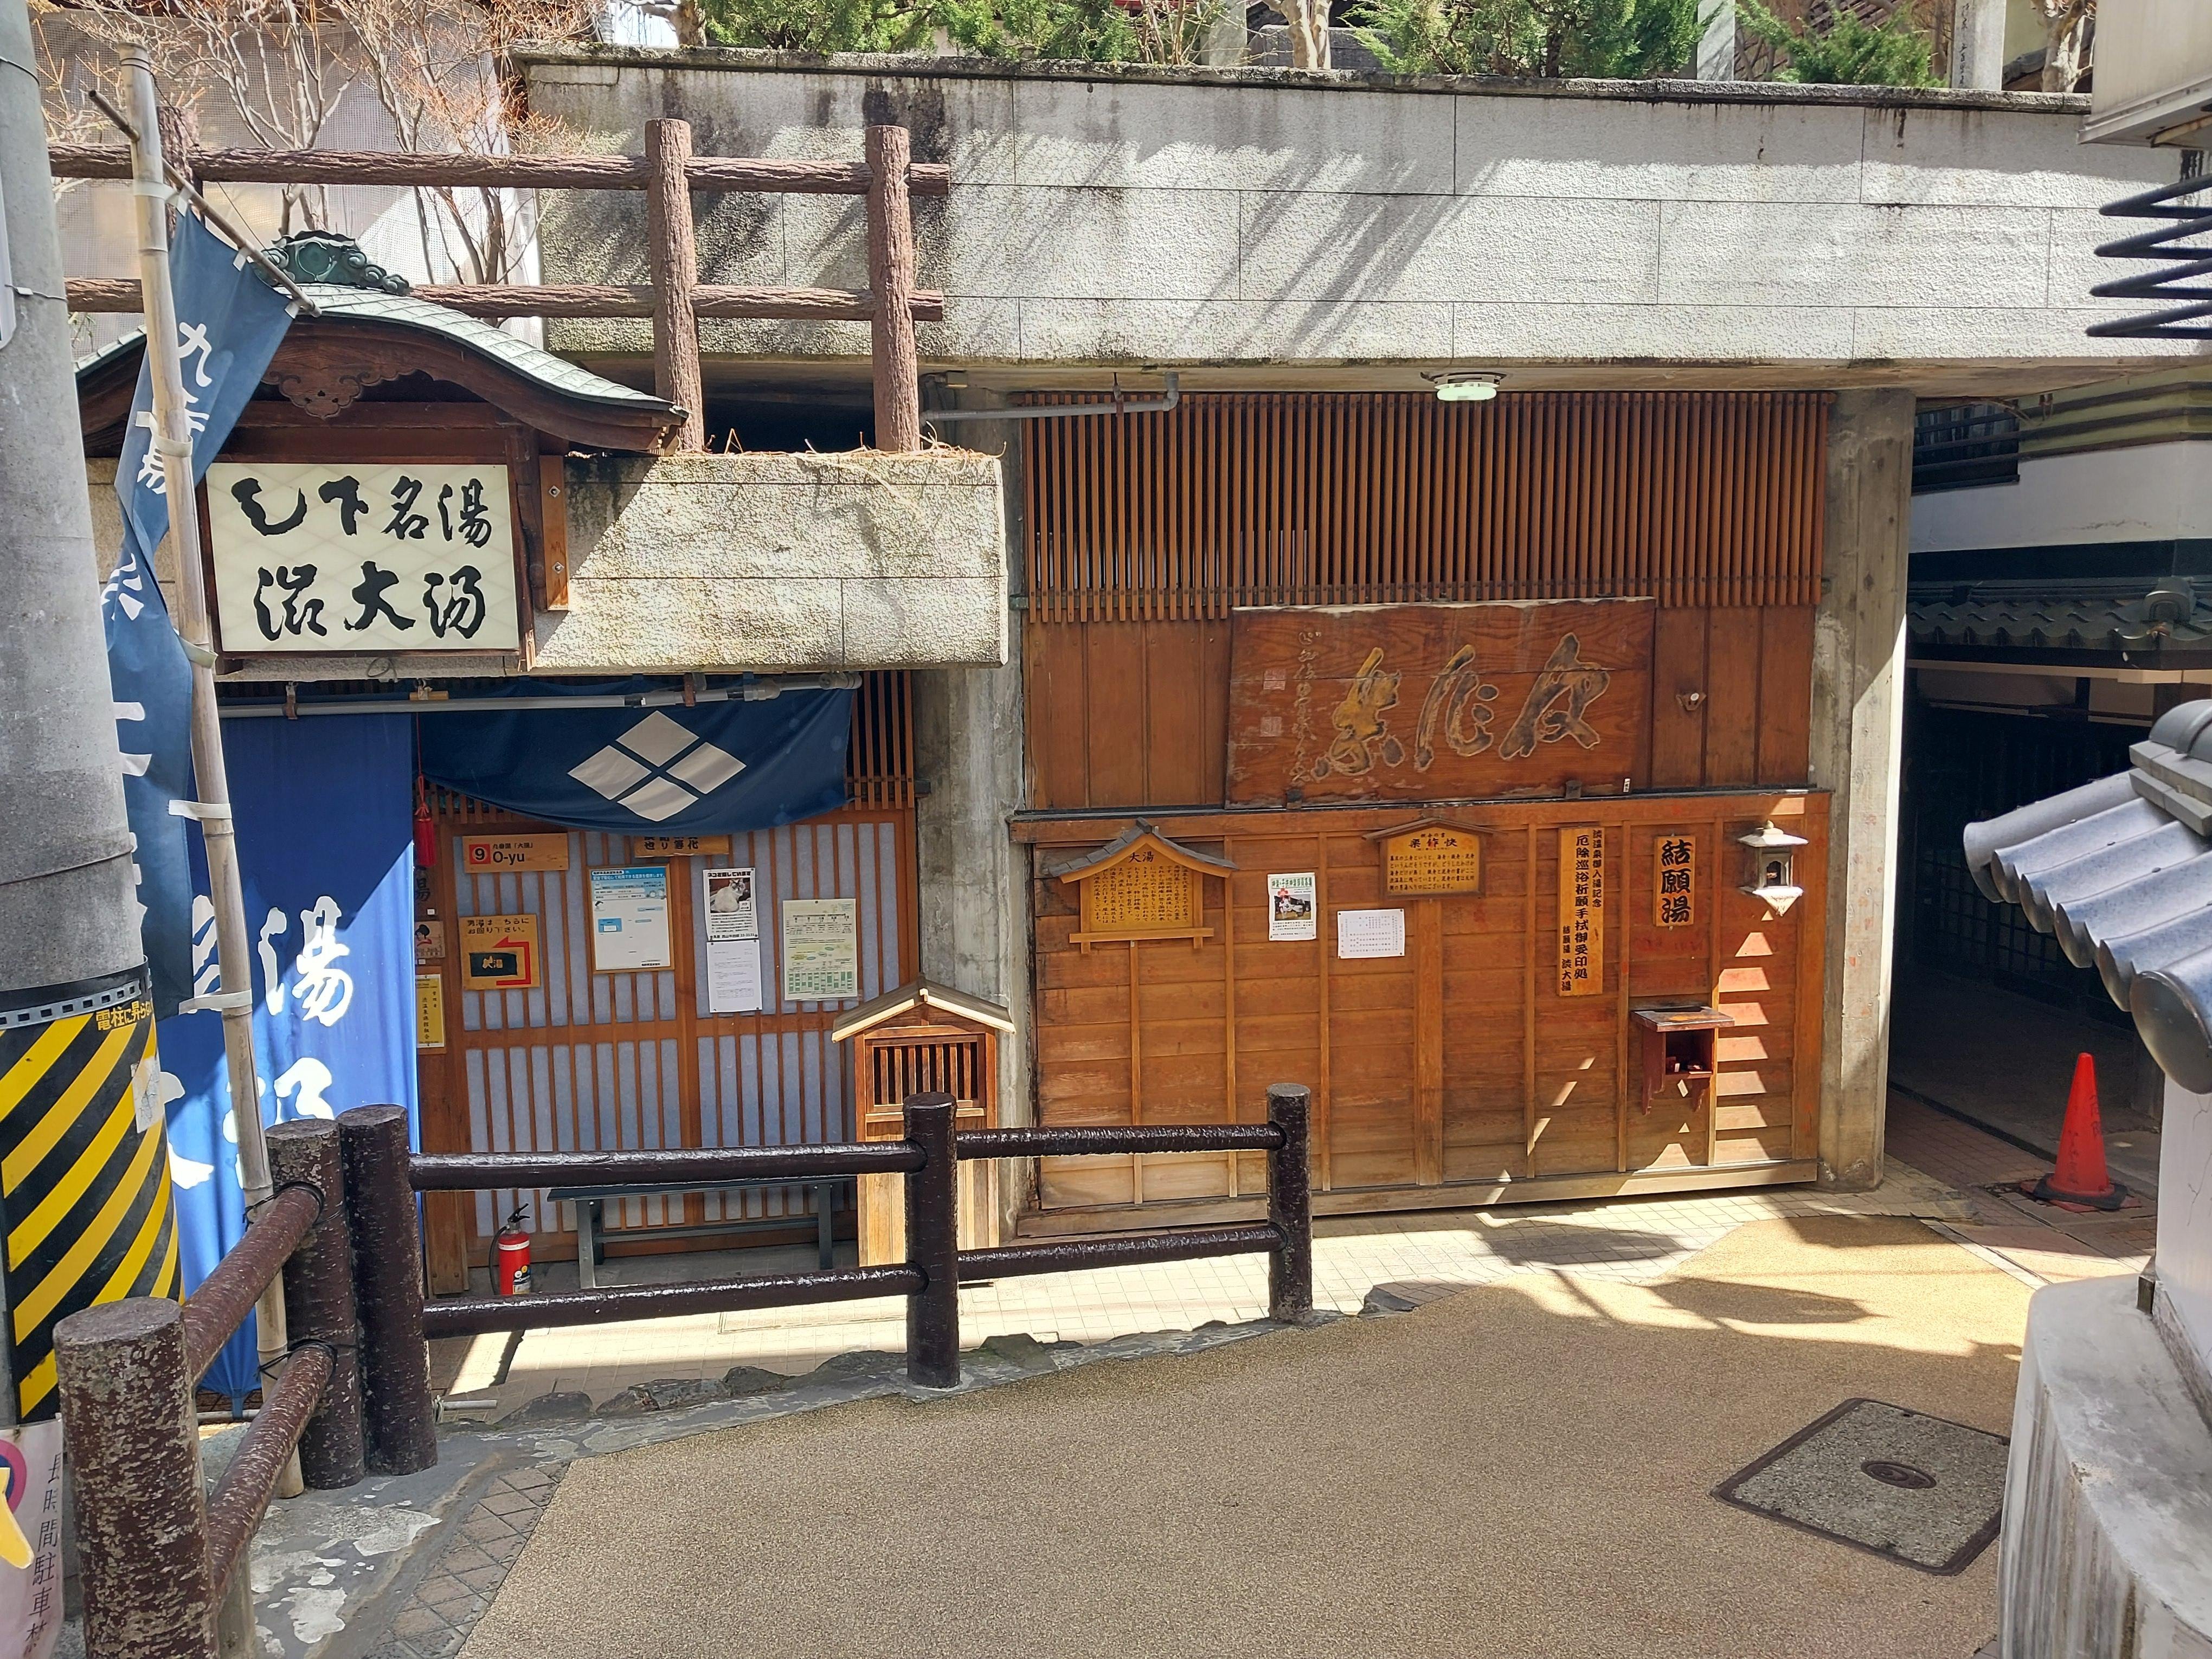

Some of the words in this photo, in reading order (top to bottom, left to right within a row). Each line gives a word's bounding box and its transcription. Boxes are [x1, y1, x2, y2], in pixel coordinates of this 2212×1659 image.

[474, 848, 485, 860] 9
[493, 851, 525, 865] O-yu
[1129, 851, 1154, 863] 大湯
[1661, 839, 1692, 923] 結願湯
[1574, 834, 1590, 979] 厄除巡浴祈願手拭御受印処
[1561, 959, 1572, 991] 渋大湯
